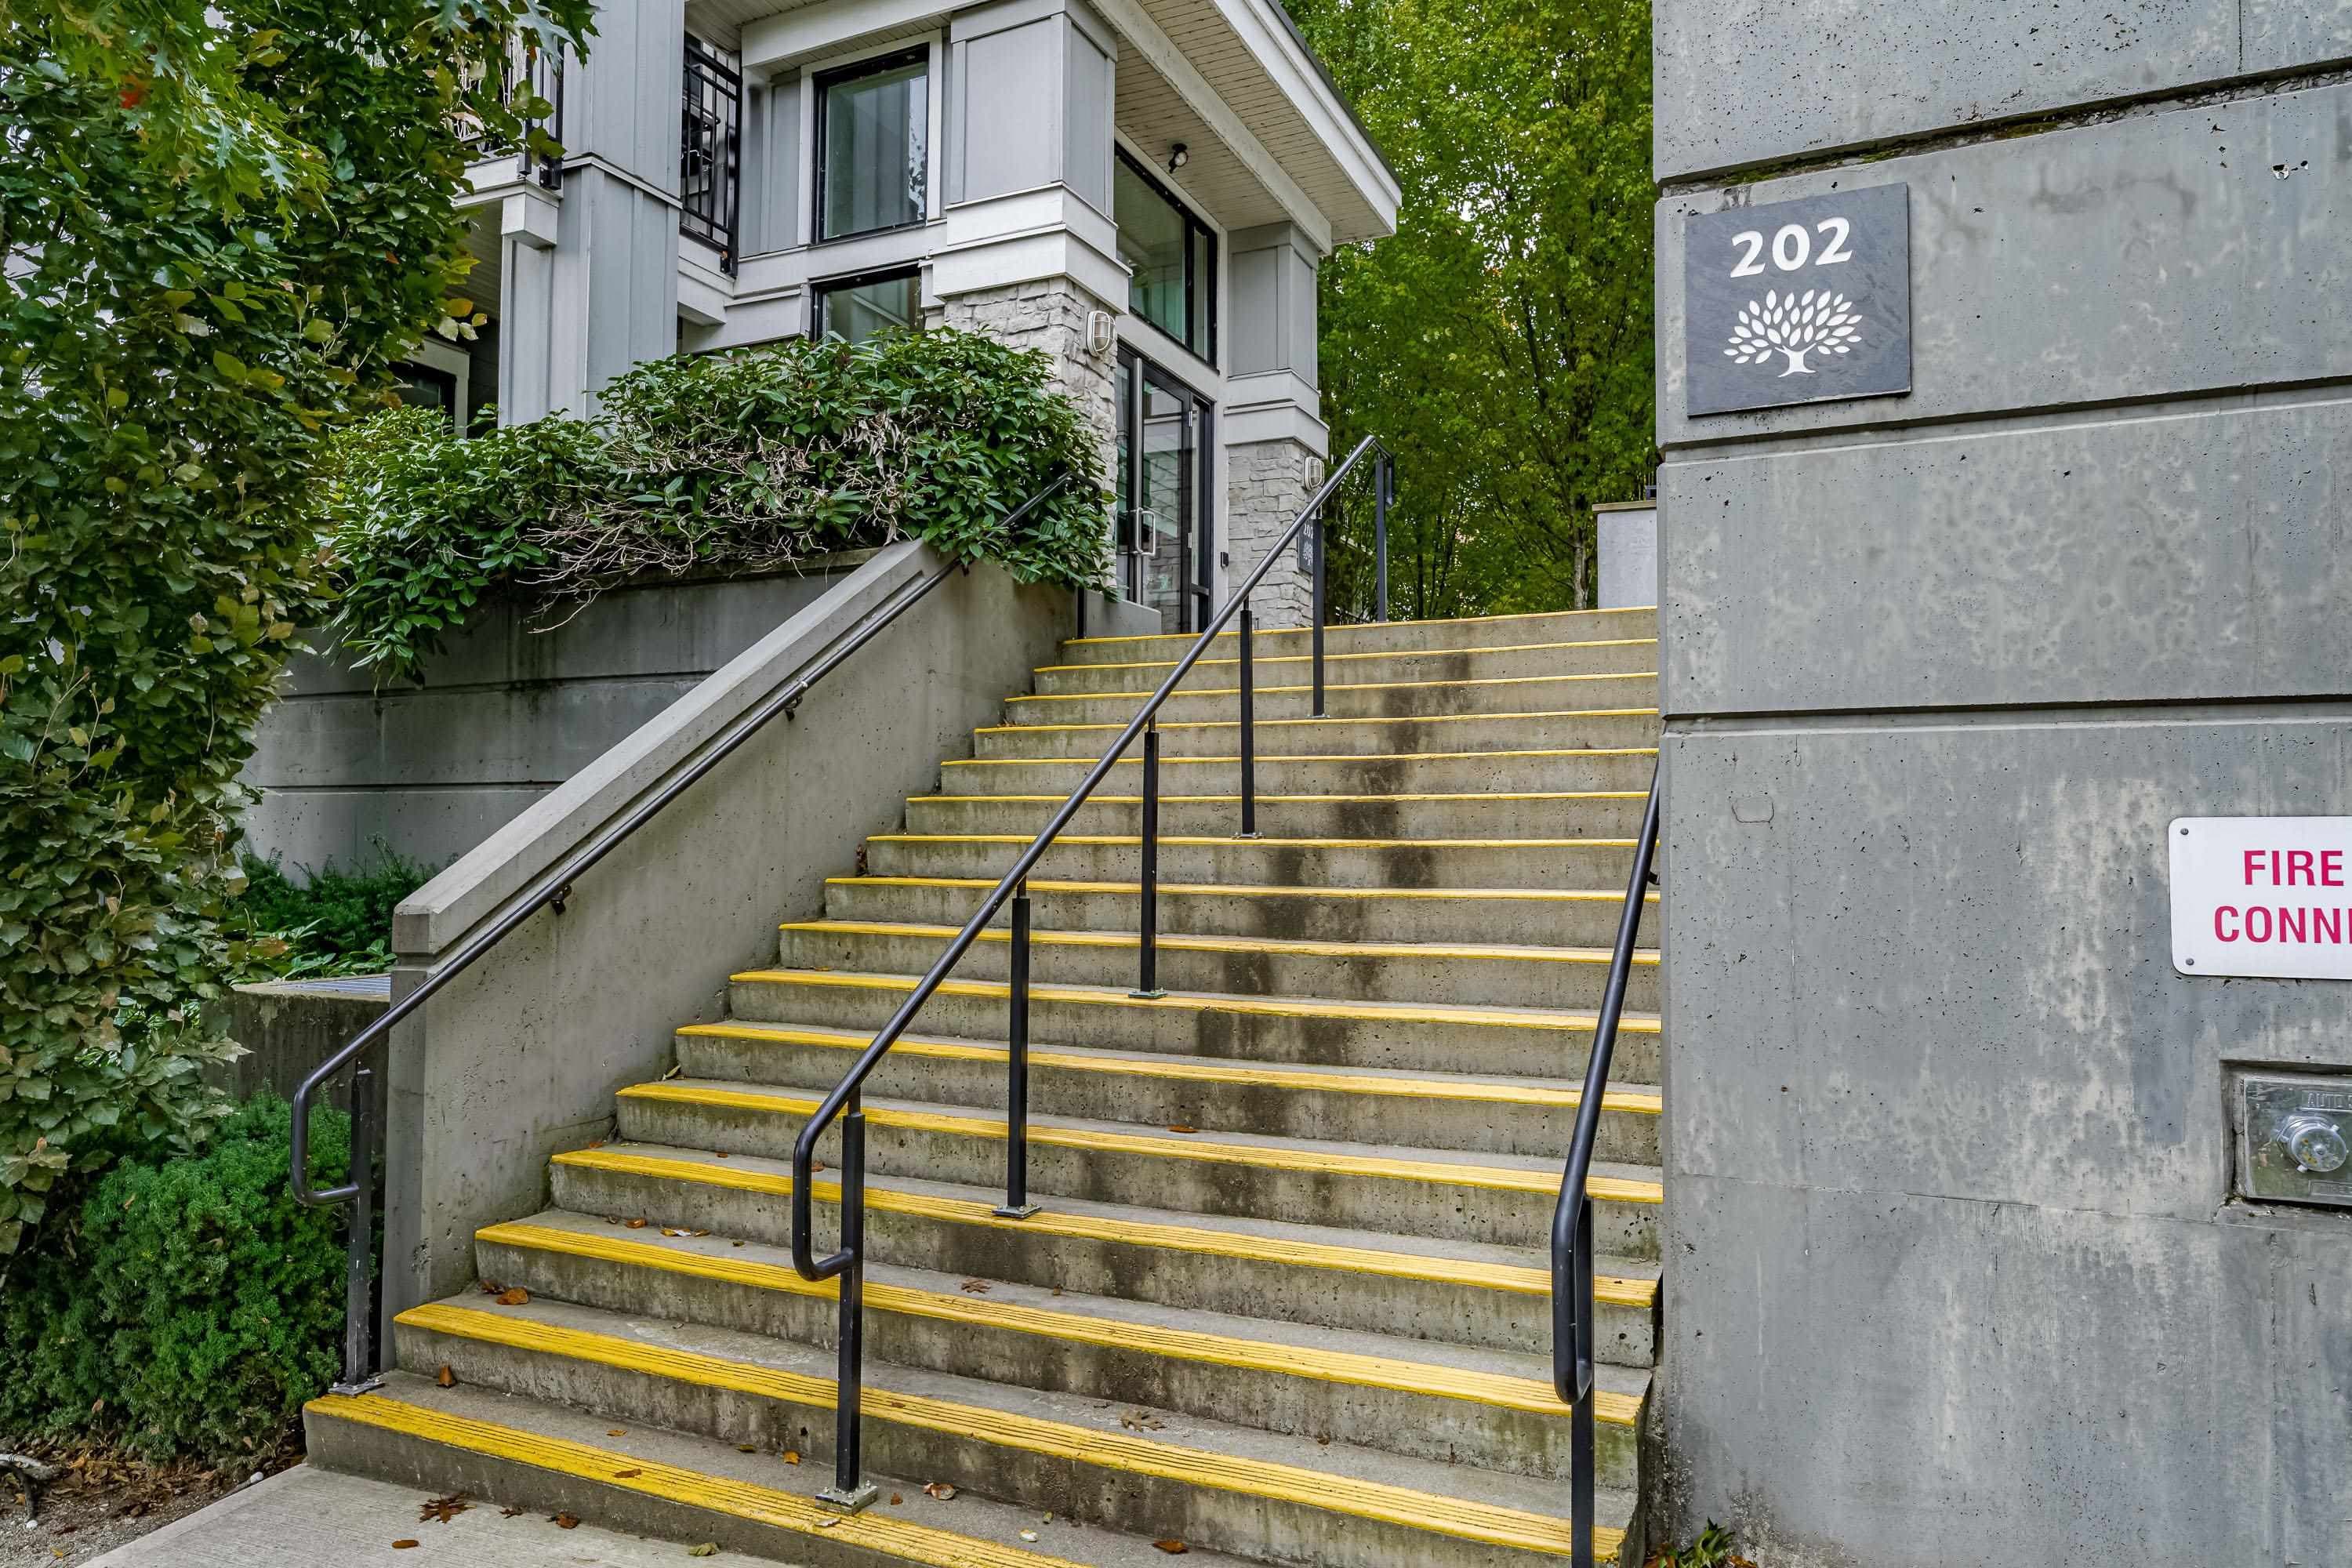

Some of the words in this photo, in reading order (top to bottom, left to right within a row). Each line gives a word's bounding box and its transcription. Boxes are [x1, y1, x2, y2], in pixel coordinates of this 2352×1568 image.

[1730, 217, 1853, 278] 202
[2244, 850, 2344, 886] FIRE
[2214, 906, 2352, 944] CONN
